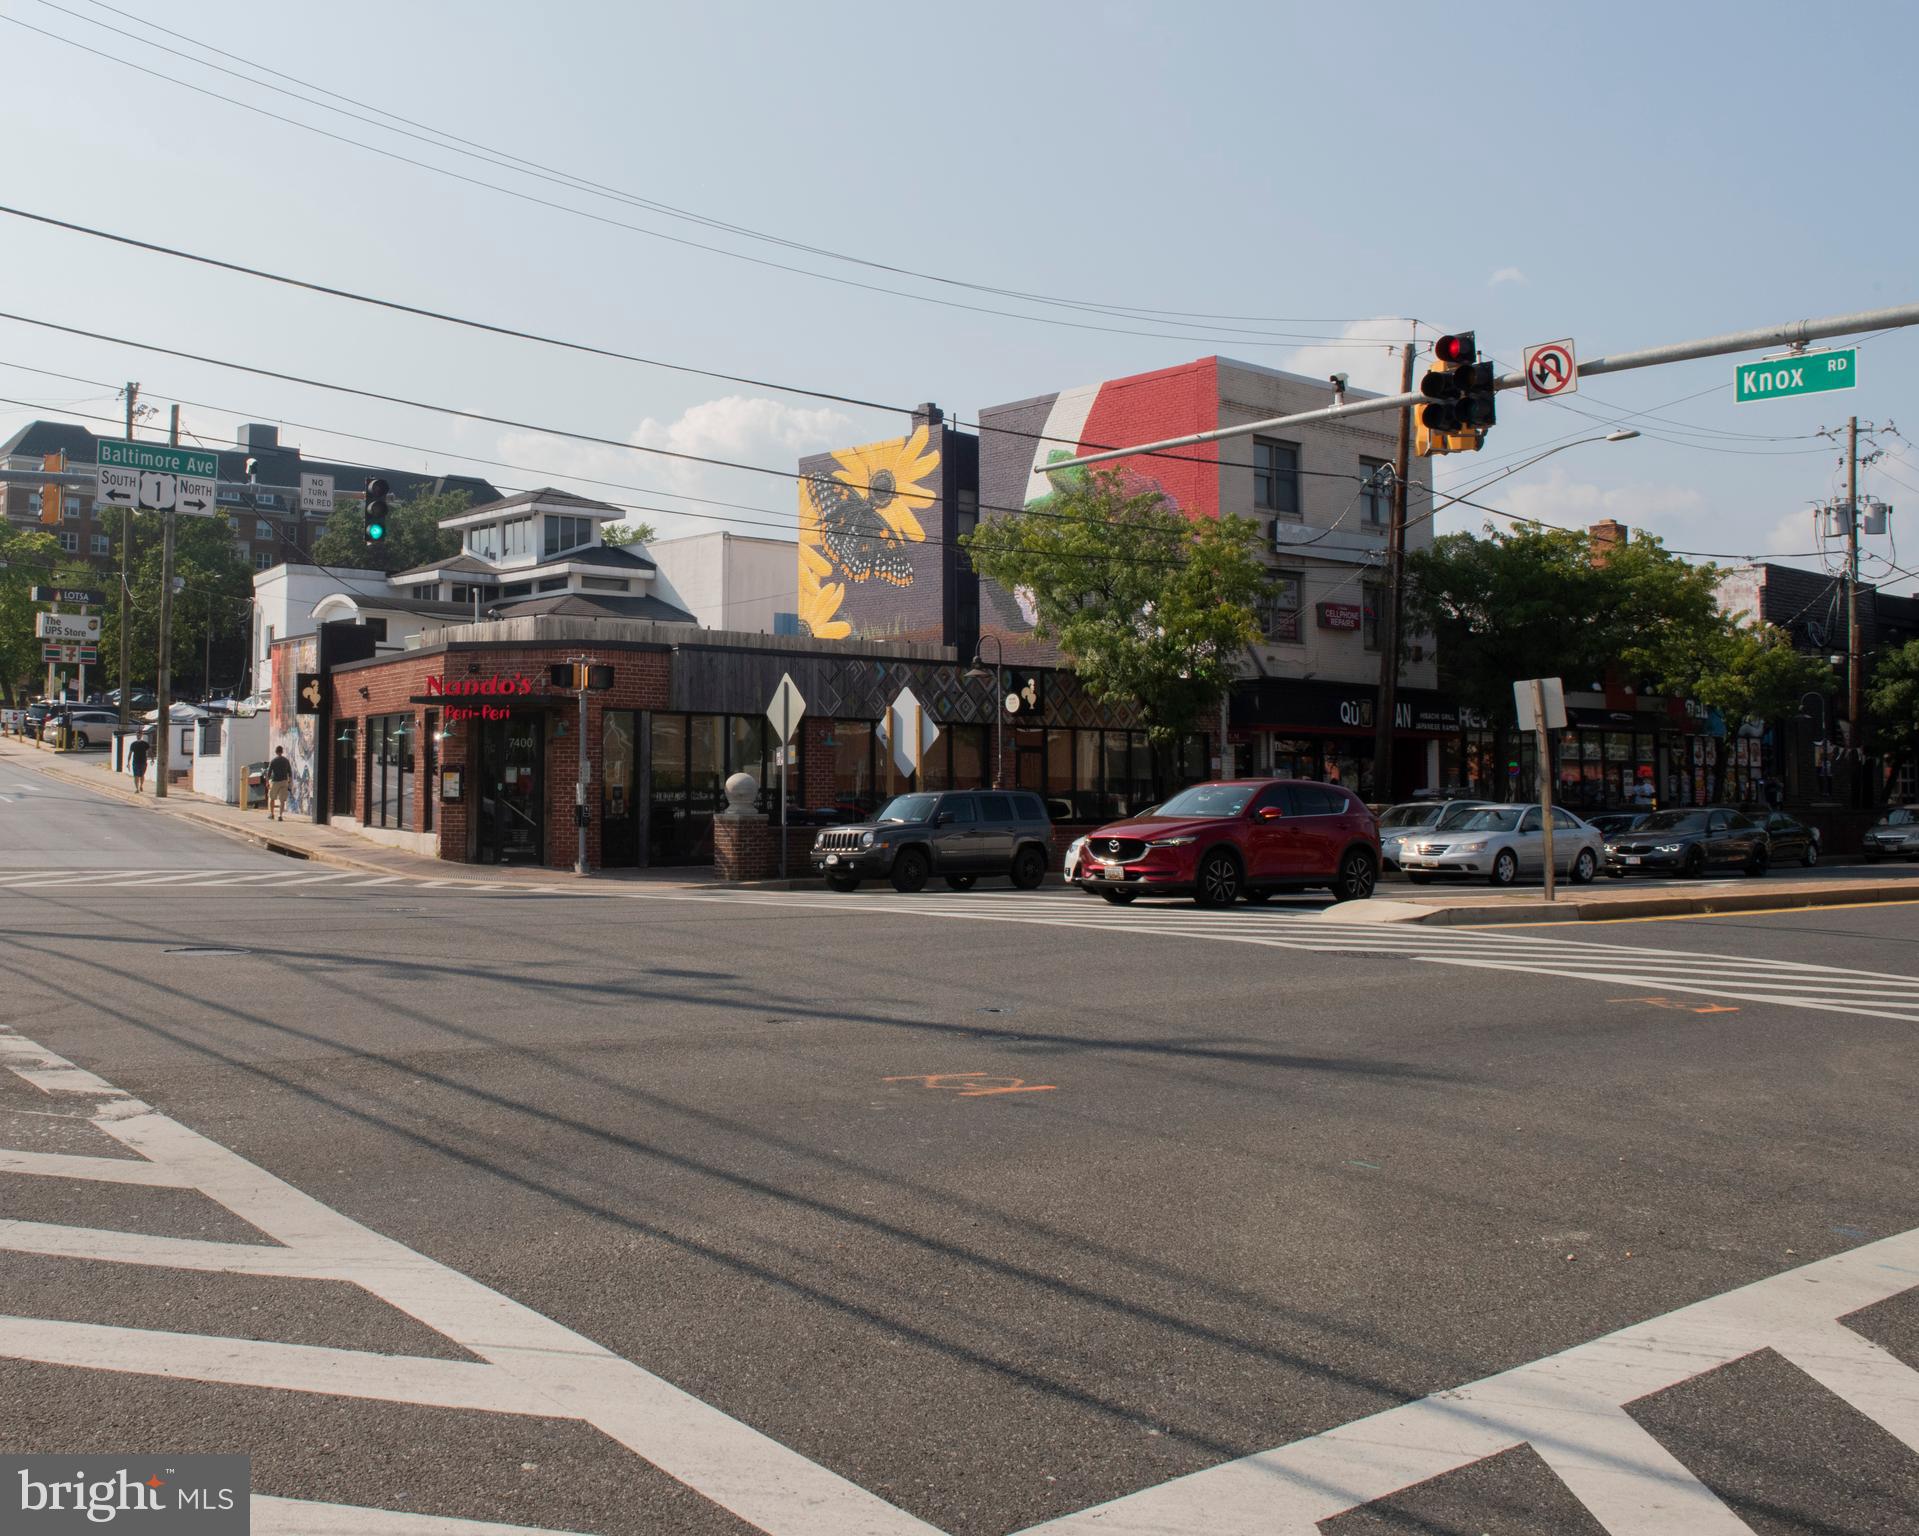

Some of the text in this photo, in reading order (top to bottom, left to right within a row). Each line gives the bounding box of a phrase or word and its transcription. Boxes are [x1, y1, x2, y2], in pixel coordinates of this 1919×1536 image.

[1744, 358, 1847, 394] Knox RD
[101, 446, 214, 474] Baltimore Ave
[101, 470, 137, 488] SOUTH
[311, 479, 324, 487] NO
[155, 481, 161, 502] 1
[180, 479, 212, 497] NORTH
[308, 488, 328, 497] TURN
[317, 499, 332, 507] RED
[63, 591, 89, 600] LOTSA
[45, 616, 62, 626] The
[45, 626, 87, 638] UPS Store
[65, 646, 77, 661] 7
[425, 672, 532, 696] Nando's
[445, 703, 511, 721] Peri-Peri
[508, 737, 534, 748] 7400
